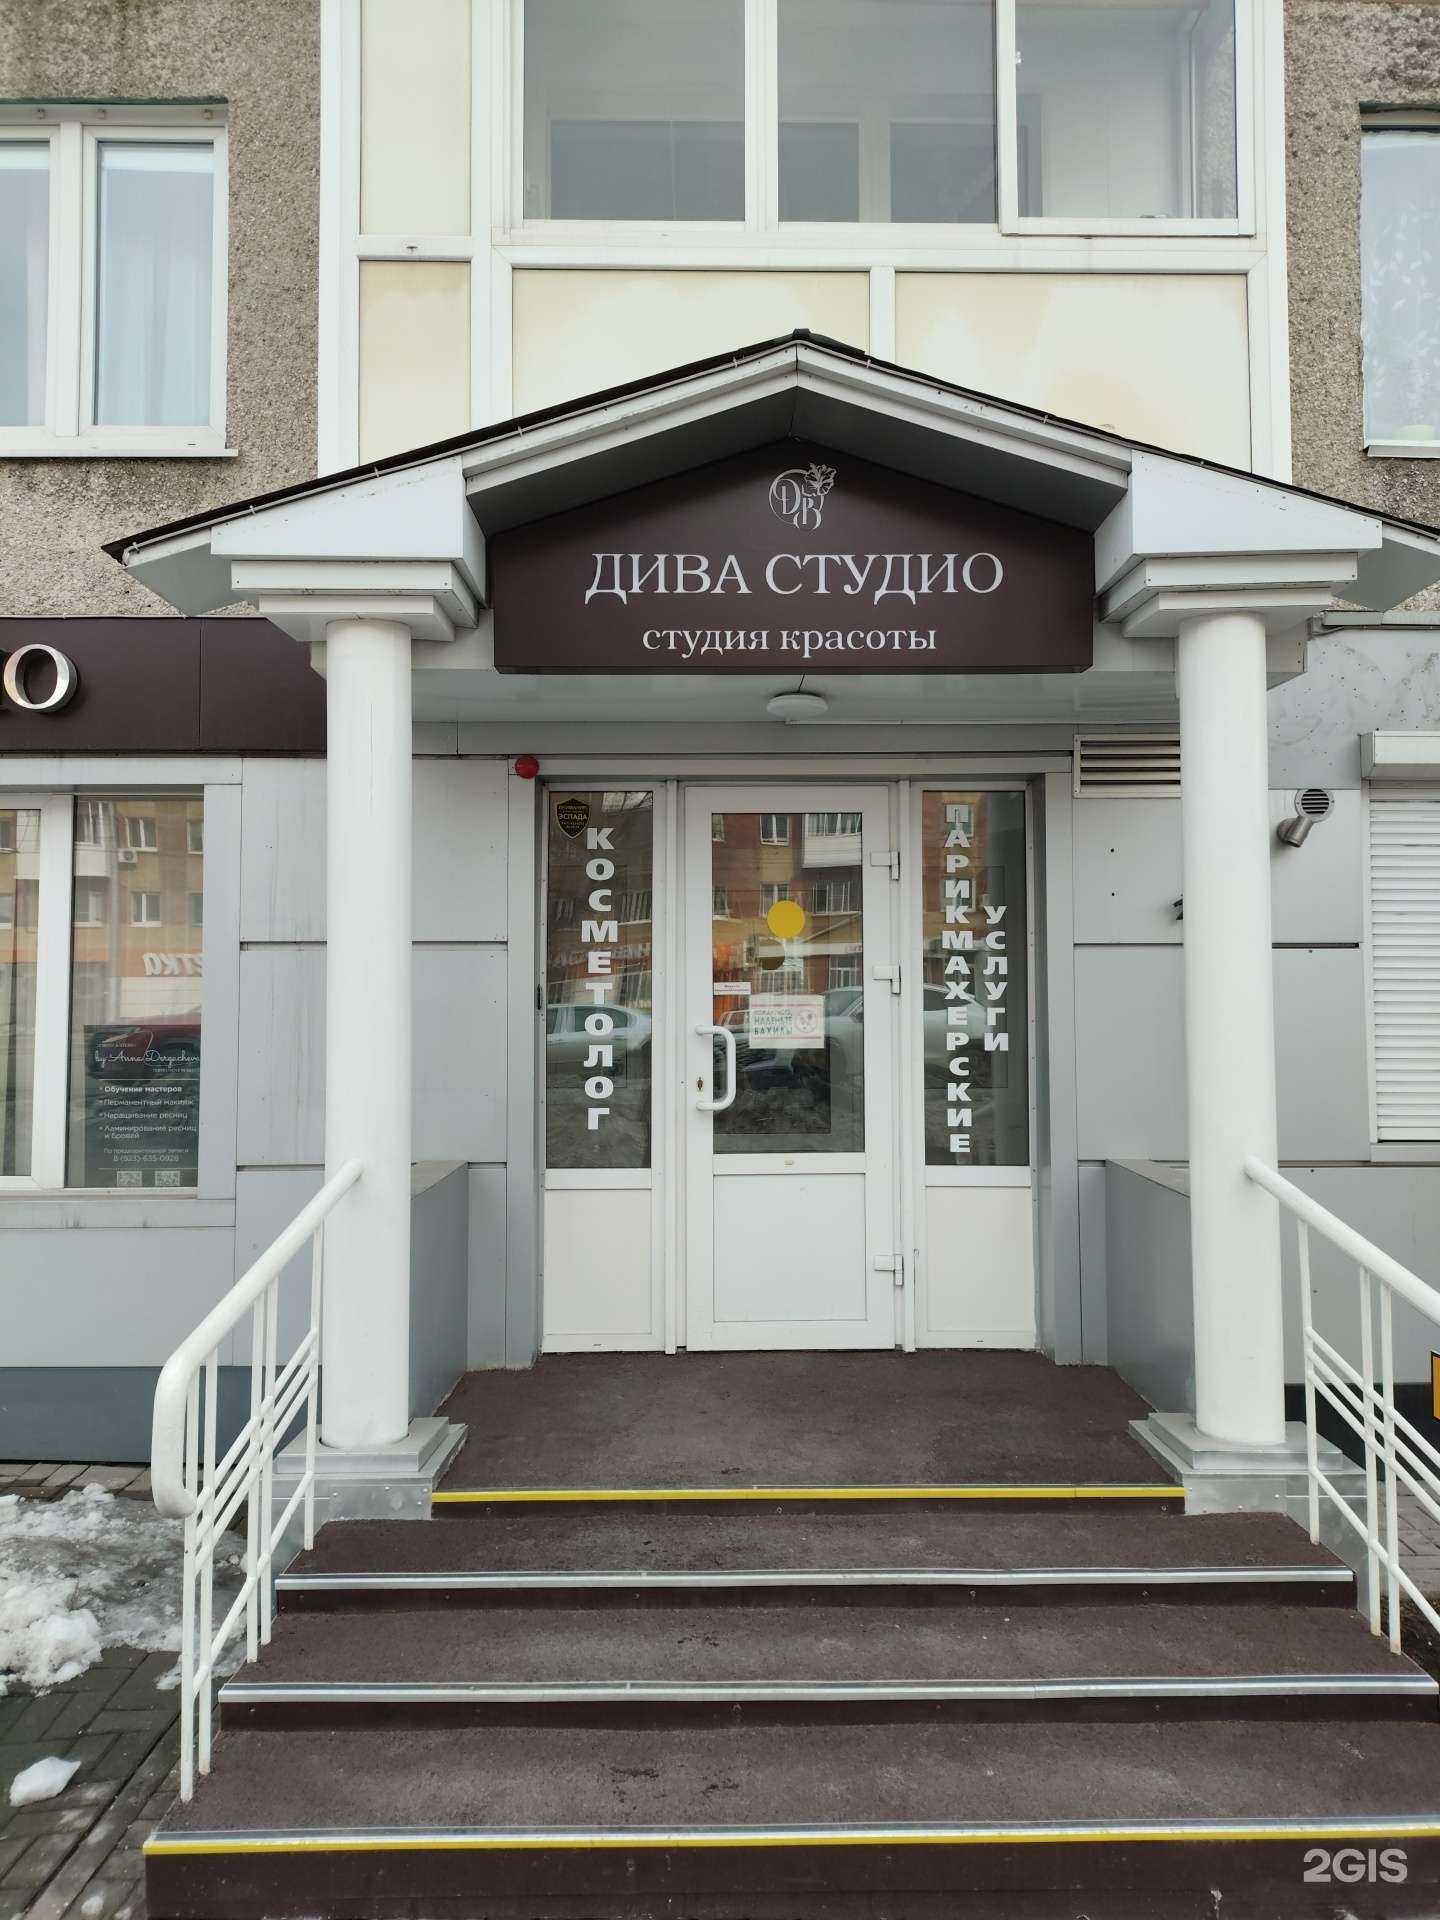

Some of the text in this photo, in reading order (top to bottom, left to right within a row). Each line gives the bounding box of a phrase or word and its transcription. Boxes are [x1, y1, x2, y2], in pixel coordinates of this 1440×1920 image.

[584, 552, 1004, 606] ДИВА СТУДИО
[642, 629, 937, 659] студия красоты
[581, 827, 618, 1130] КОСМЕТОЛОГ
[942, 804, 975, 1152] ПАРИКМАХЕРСКИЕ
[983, 905, 1009, 1051] УСЛУГИ
[104, 1086, 143, 1094] Обучение
